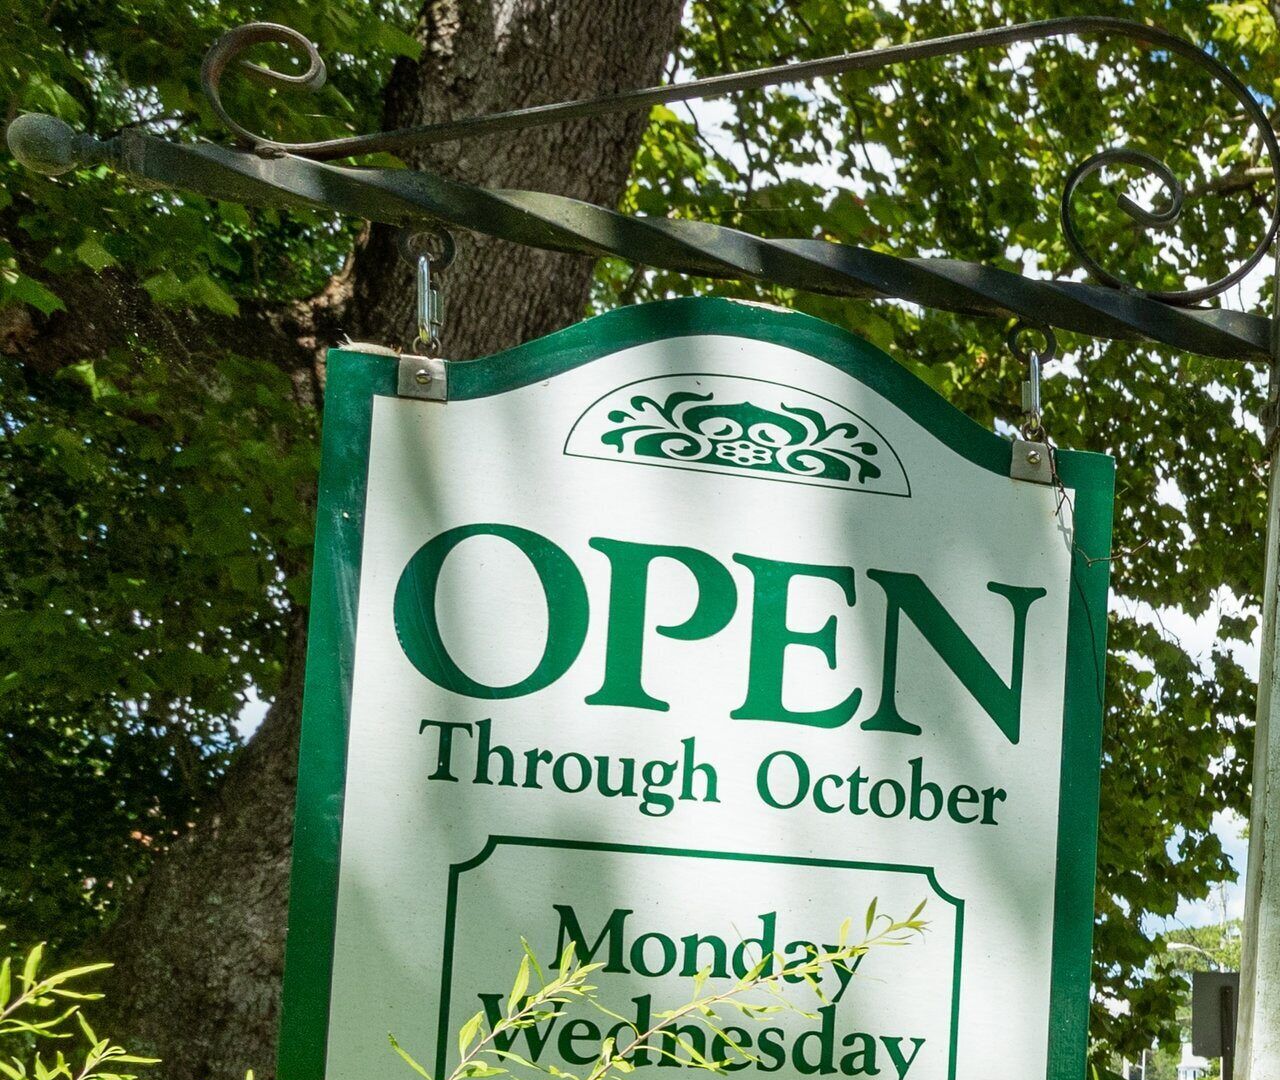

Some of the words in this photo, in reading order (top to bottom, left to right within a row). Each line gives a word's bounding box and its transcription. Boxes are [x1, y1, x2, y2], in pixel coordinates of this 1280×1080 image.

[393, 523, 1047, 745] OPEN
[419, 718, 720, 816] Through
[756, 750, 1007, 827] October
[548, 904, 868, 1003] Monday
